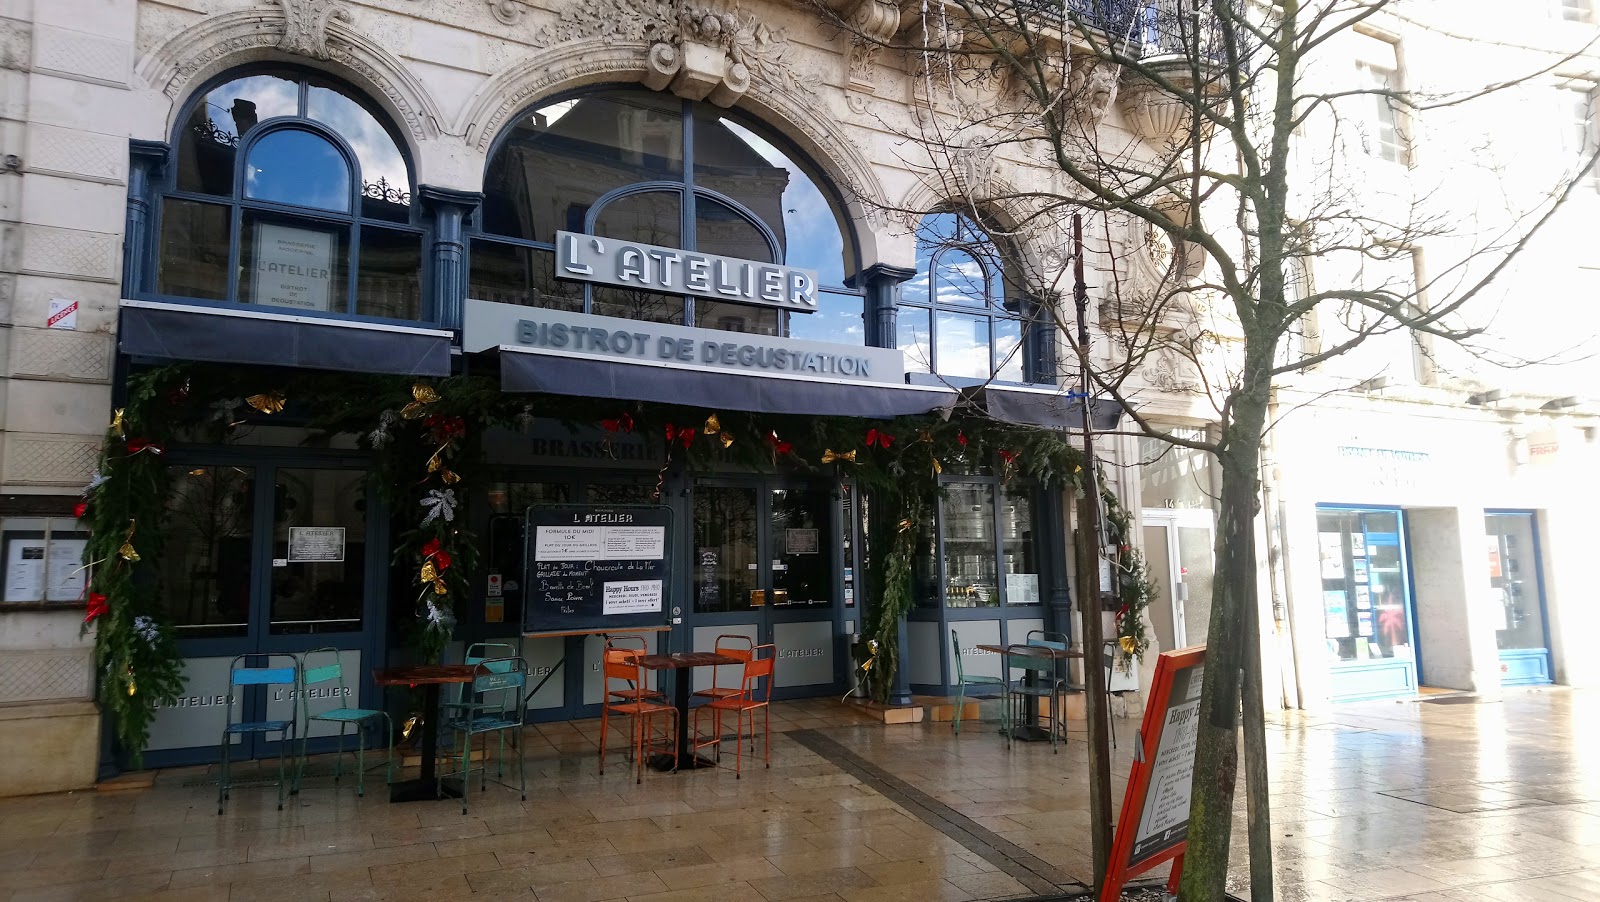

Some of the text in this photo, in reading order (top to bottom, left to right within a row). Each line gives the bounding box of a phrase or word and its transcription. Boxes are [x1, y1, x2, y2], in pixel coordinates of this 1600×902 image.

[277, 240, 316, 249] BRASSERIE
[258, 261, 328, 279] L'ATELIER
[280, 284, 307, 292] BISTROT
[271, 297, 314, 307] DEGUSTATION
[51, 304, 75, 323] LICENCE
[518, 319, 871, 376] BISTROT DE DEGUSTATION
[532, 438, 658, 460] BRASSERIE
[605, 585, 623, 594] Happy
[1169, 707, 1195, 725] Happy
